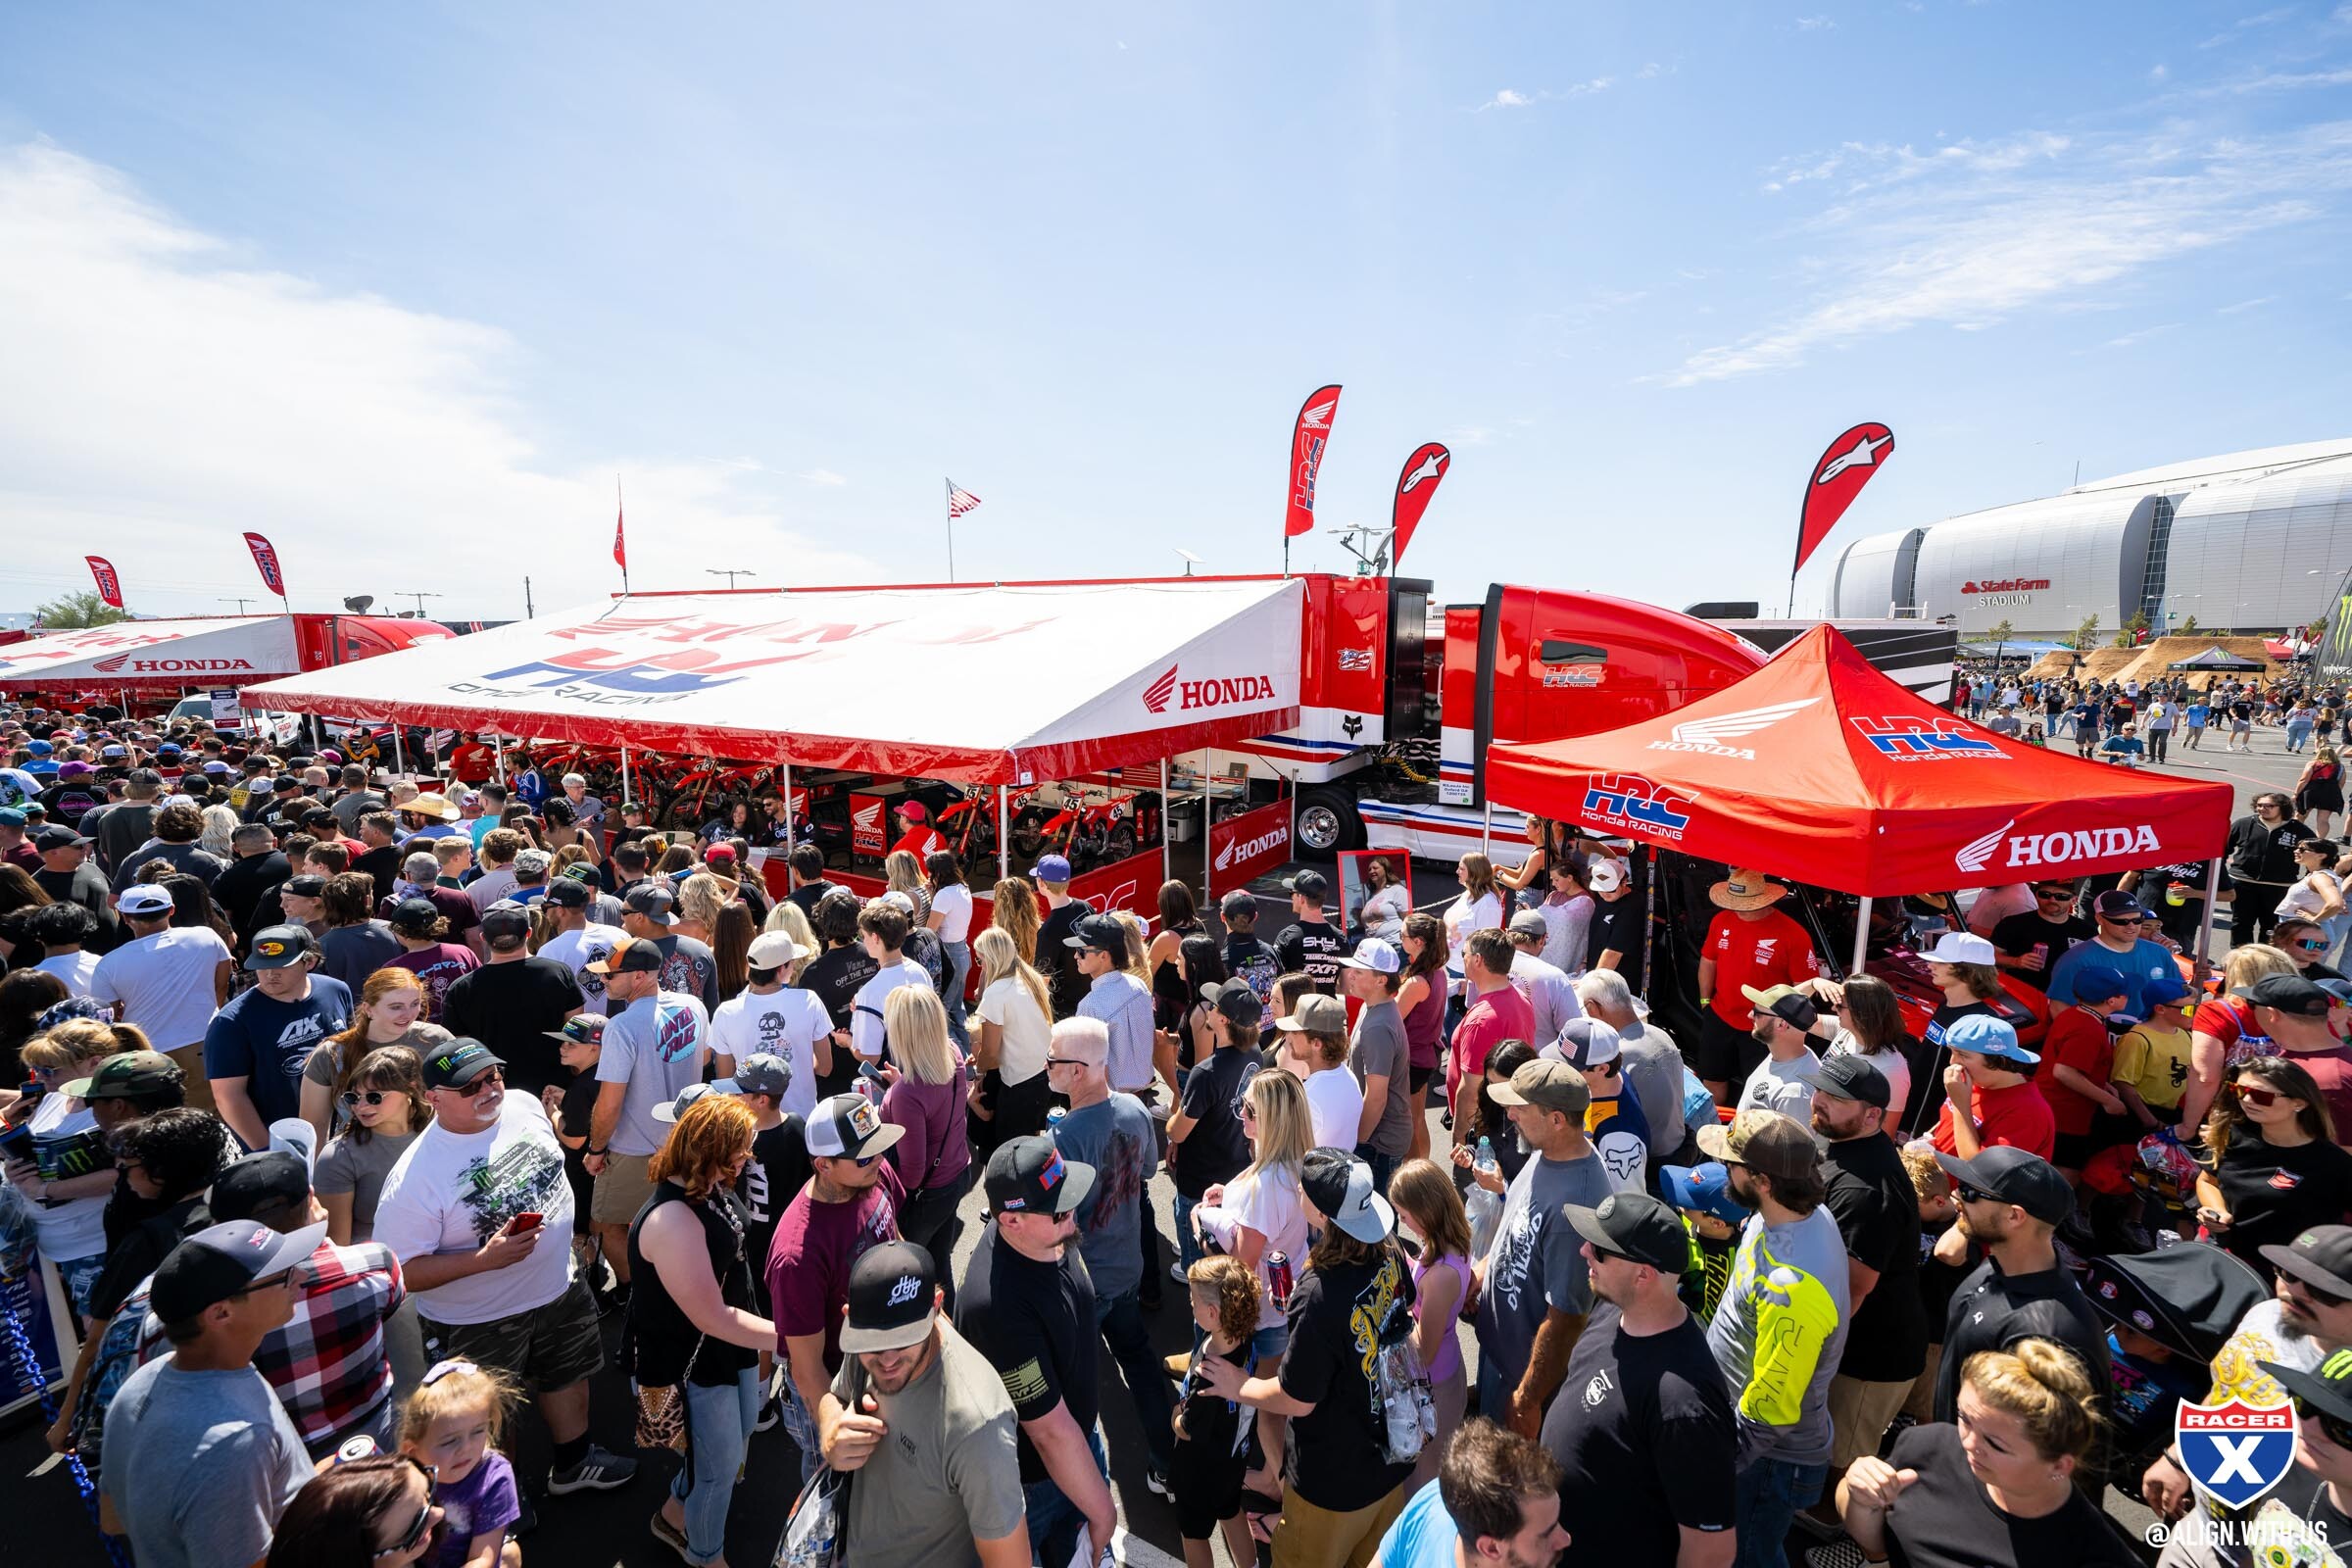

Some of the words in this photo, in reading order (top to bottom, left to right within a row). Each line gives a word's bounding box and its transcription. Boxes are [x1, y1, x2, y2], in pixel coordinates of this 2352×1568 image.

[1979, 595, 2031, 608] STADIUM
[132, 659, 255, 672] HONDA
[1543, 665, 1602, 684] HRC
[2323, 663, 2352, 676] MONSTE
[1180, 675, 1275, 710] HONDA
[1849, 715, 2000, 754] HRC
[1645, 740, 1756, 760] HONDA
[1886, 752, 1948, 762] Honda
[1948, 750, 2014, 760] RACING
[964, 787, 978, 799] 45
[1016, 796, 1028, 808] 45
[1582, 771, 1700, 830] HRC
[1063, 798, 1080, 809] 45
[1112, 806, 1124, 819] 45
[854, 825, 883, 834] HONDA
[1581, 808, 1626, 827] Honda
[1627, 820, 1683, 841] RACING
[1234, 827, 1288, 864] HONDA
[2006, 824, 2162, 867] HONDA
[1302, 936, 1336, 948] SKY
[846, 958, 866, 974] Vans
[1301, 963, 1339, 974] FXR
[835, 975, 848, 987] OFF
[849, 969, 861, 981] THE
[278, 1012, 321, 1044] AX
[656, 1006, 695, 1053] SANTA
[665, 1024, 696, 1064] CRUZ
[745, 1157, 769, 1224] FOX
[900, 1431, 917, 1457] VANS
